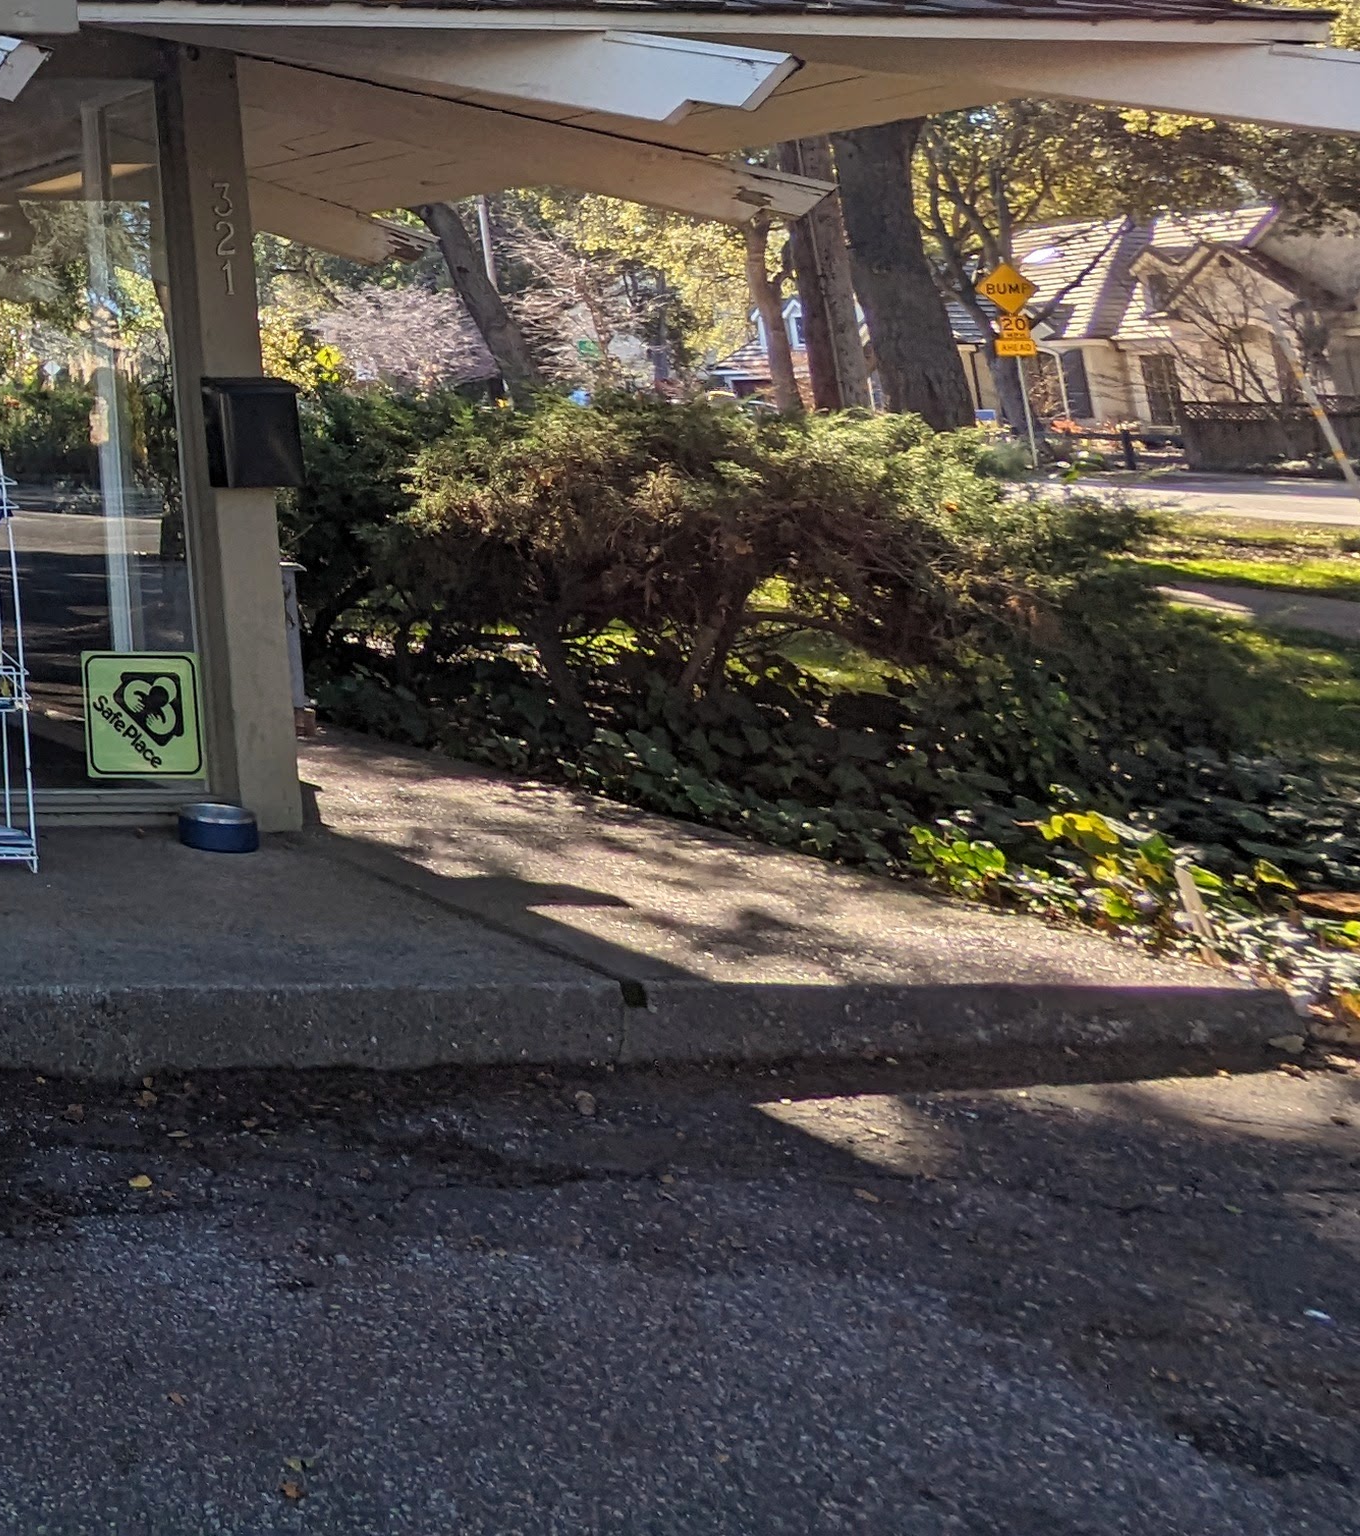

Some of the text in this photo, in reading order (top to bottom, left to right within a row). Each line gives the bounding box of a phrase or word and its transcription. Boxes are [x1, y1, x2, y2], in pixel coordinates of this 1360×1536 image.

[986, 283, 1031, 295] BUMP
[1001, 318, 1026, 331] 20
[1002, 344, 1032, 352] AHEAD
